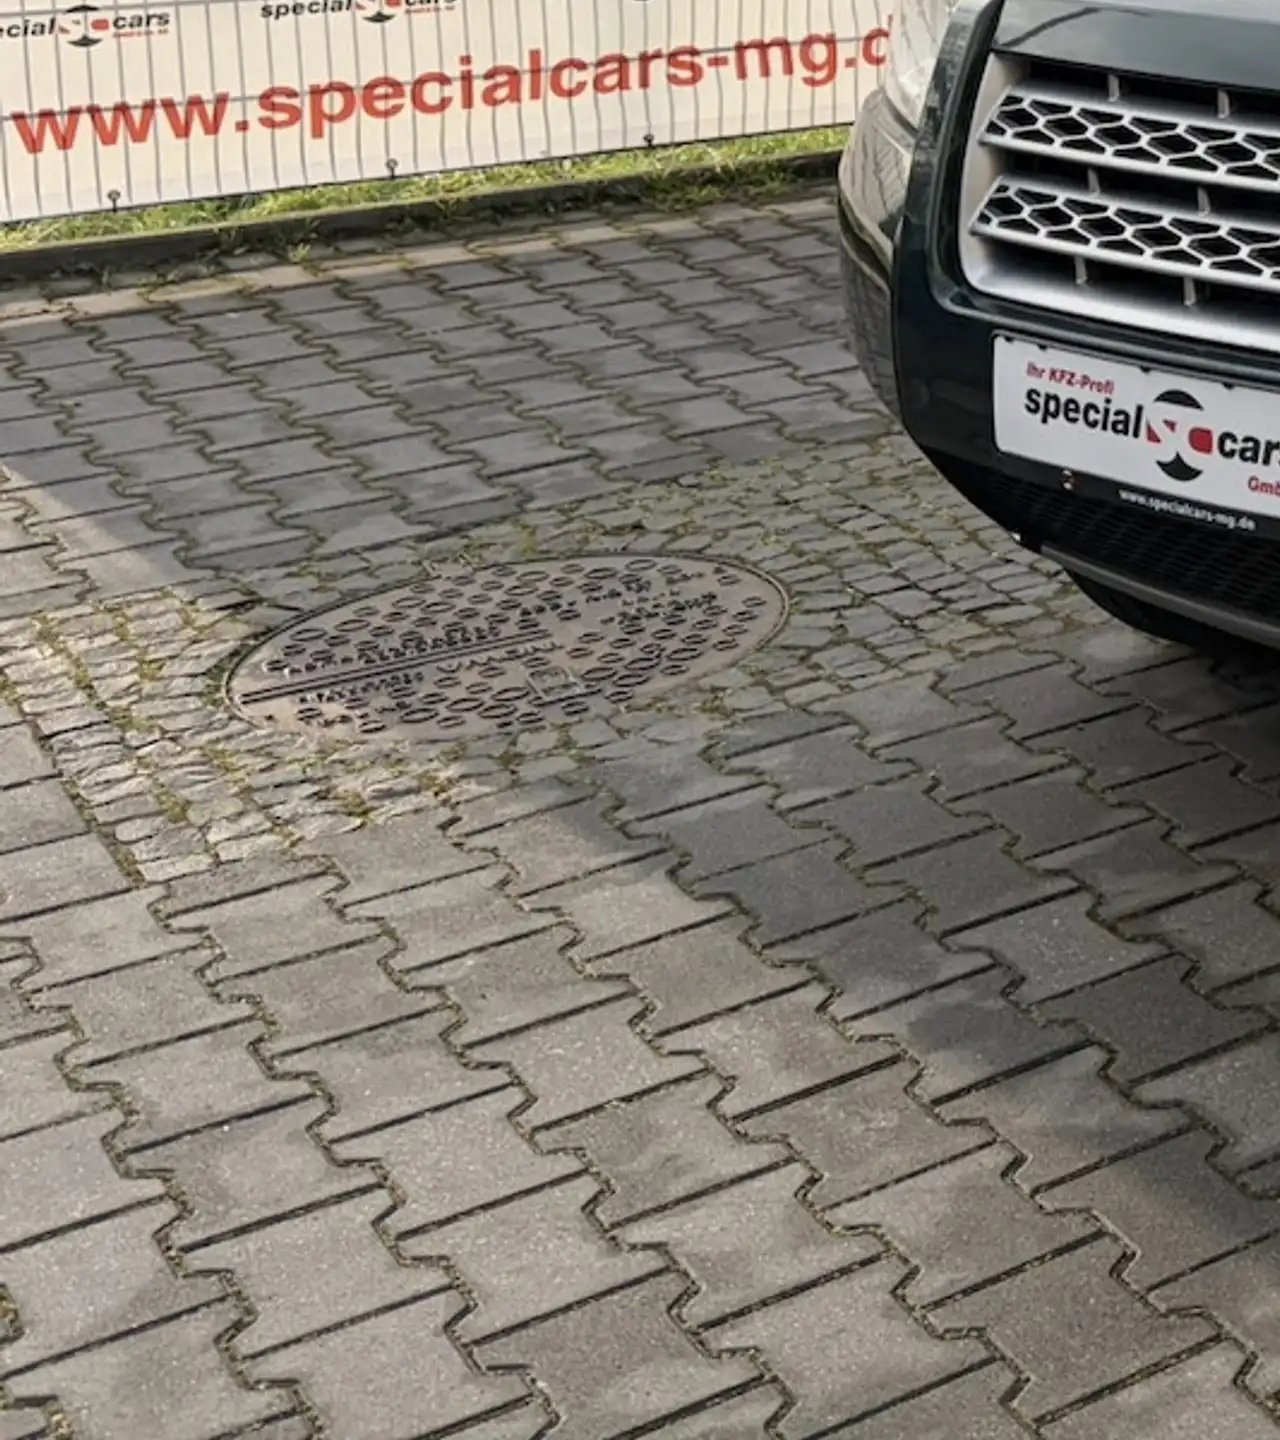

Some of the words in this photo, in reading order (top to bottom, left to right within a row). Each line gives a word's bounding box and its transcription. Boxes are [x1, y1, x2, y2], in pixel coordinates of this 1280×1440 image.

[0, 17, 57, 38] cial
[112, 13, 170, 30] cars
[10, 13, 892, 155] www.specialcars-mg.d
[1026, 362, 1047, 381] Ihr
[1047, 367, 1115, 397] KFZ-Profi
[1024, 386, 1144, 439] special
[1118, 488, 1257, 532] www.specialcars-mg.de
